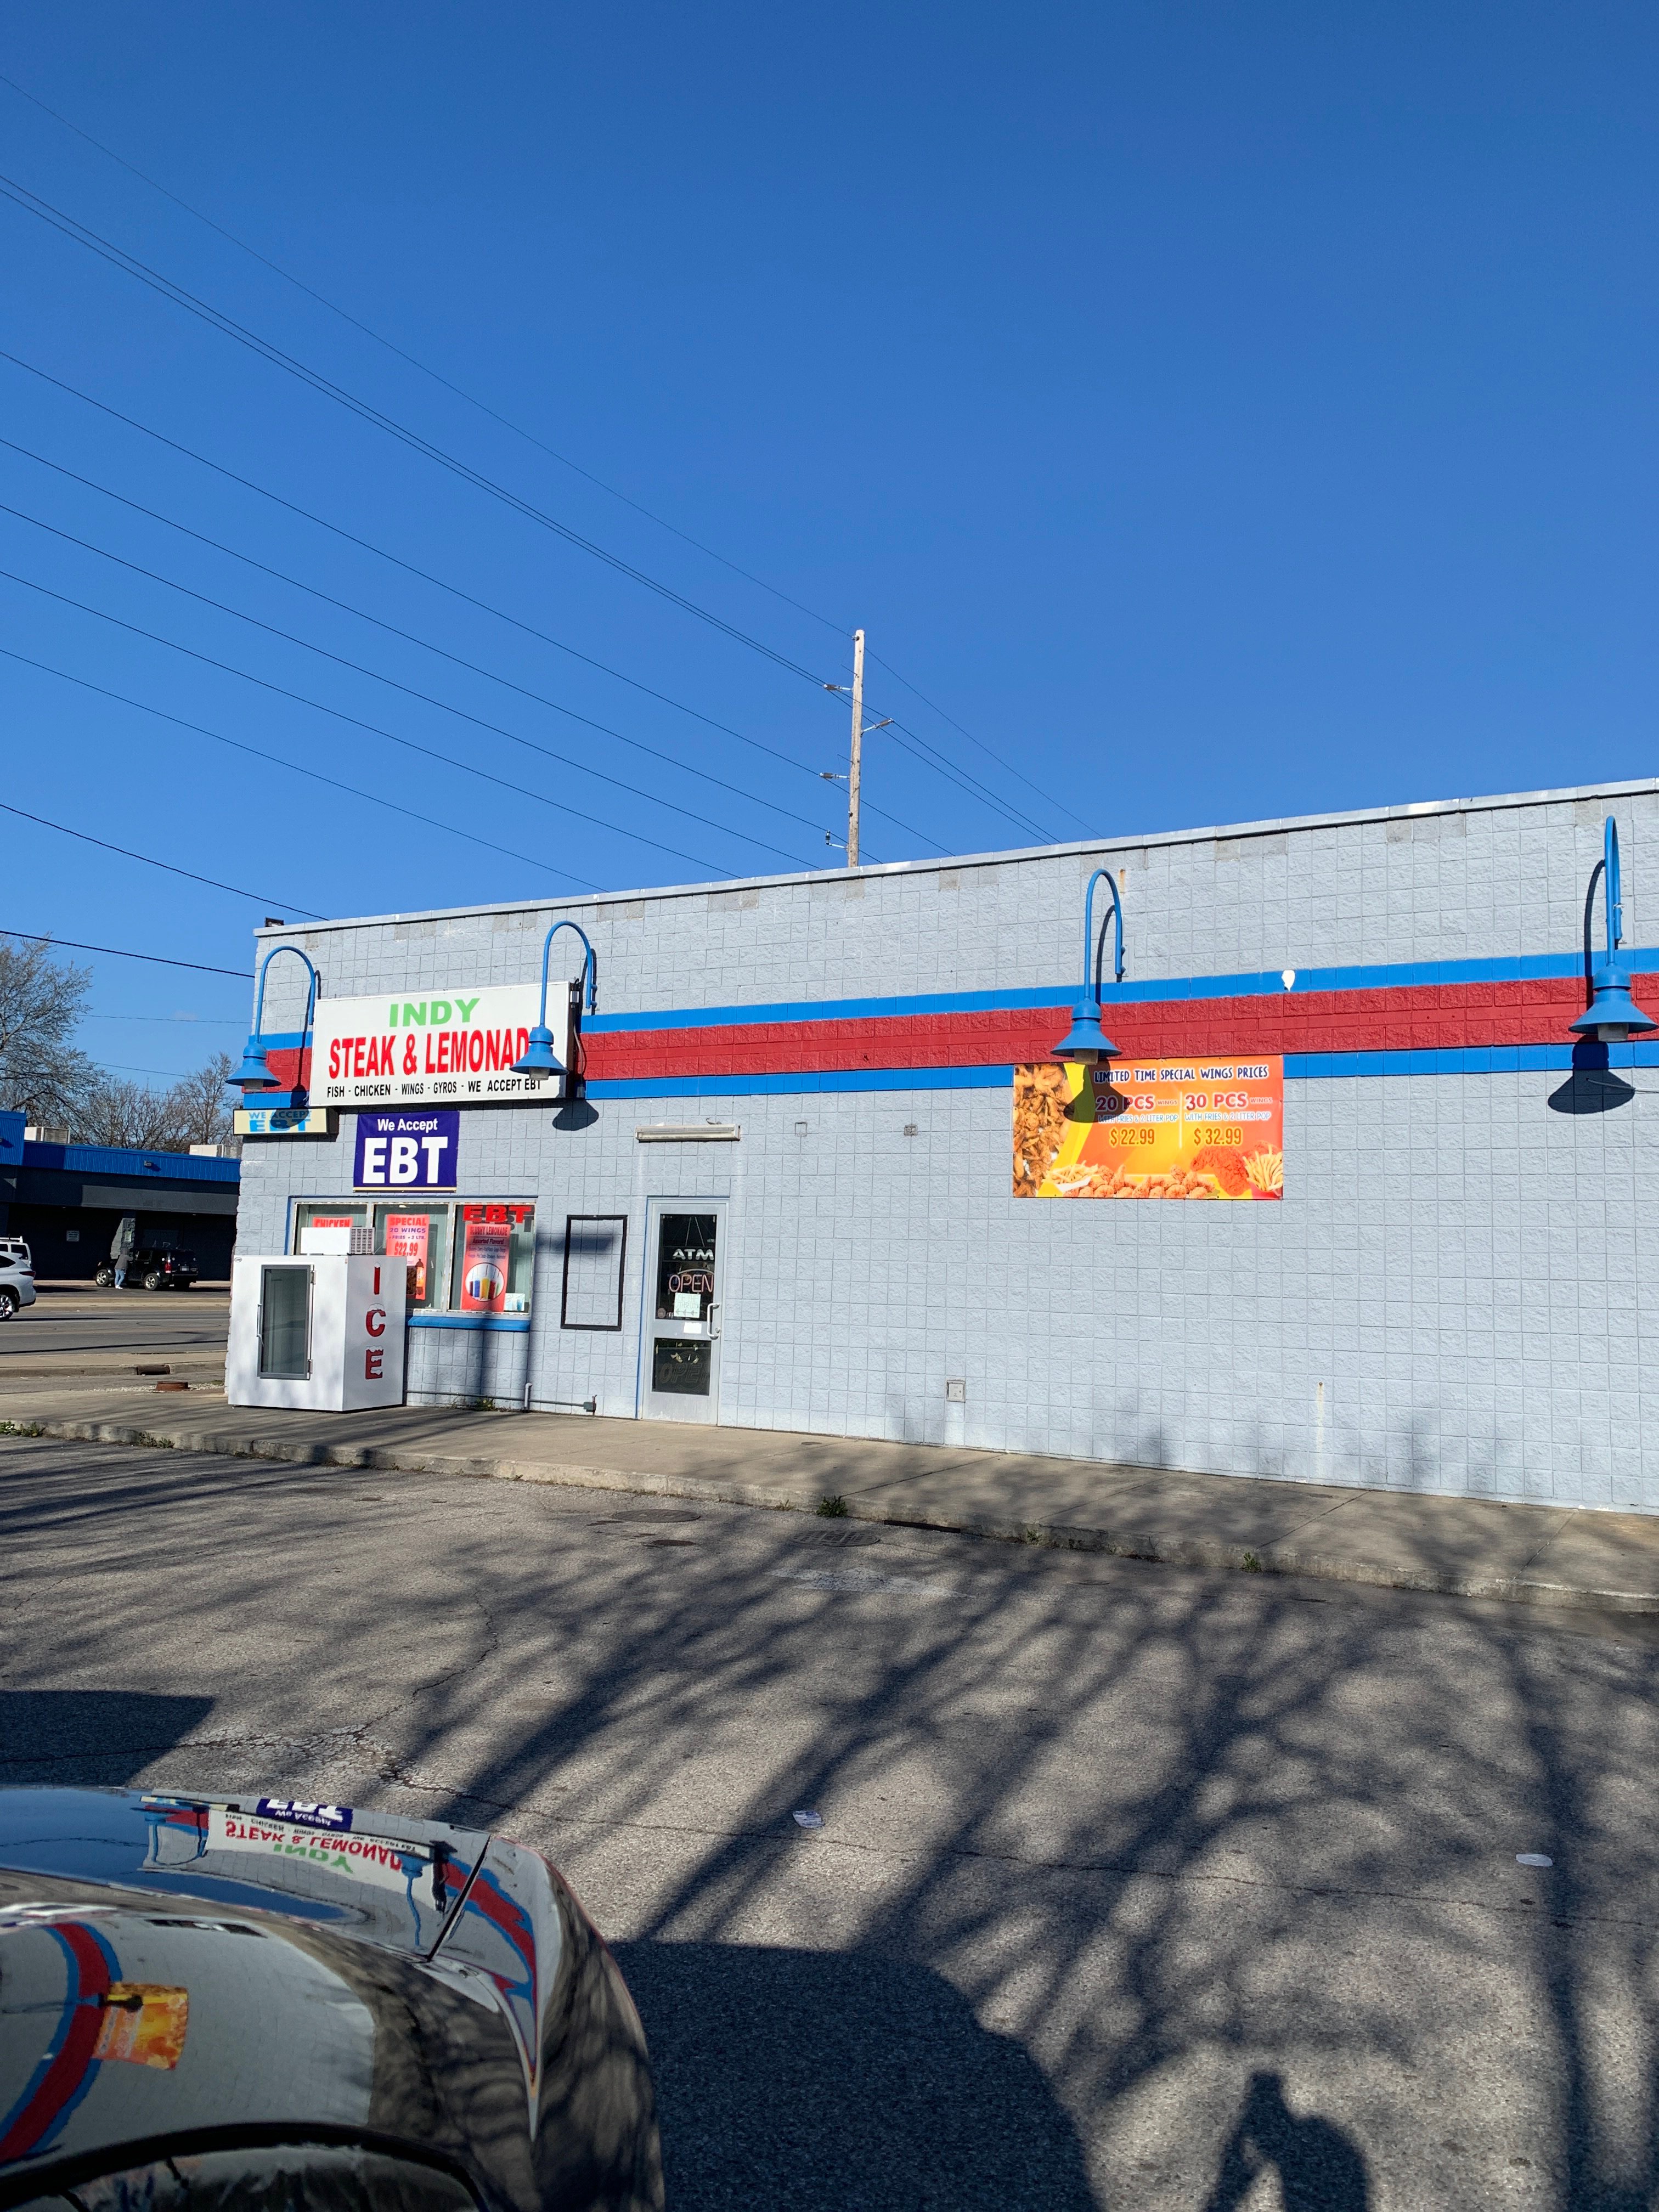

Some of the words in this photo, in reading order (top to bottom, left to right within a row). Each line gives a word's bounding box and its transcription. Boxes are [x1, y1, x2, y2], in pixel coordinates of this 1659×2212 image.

[390, 998, 480, 1027] INDY
[329, 1035, 396, 1079] STEAK
[403, 1034, 417, 1075] &
[425, 1027, 536, 1074] LEMONAD
[1094, 1071, 1130, 1082] LIMITED
[1135, 1070, 1155, 1081] TIME
[1161, 1069, 1195, 1080] SPECIAL
[1200, 1068, 1233, 1079] WINGS
[1238, 1066, 1268, 1078] PRICES
[327, 1086, 345, 1098] FISH
[354, 1084, 391, 1097] CHICKEN
[402, 1083, 424, 1095] WINGS
[433, 1081, 457, 1094] GYROS
[468, 1080, 481, 1092] WE
[487, 1079, 522, 1091] ACCEPT
[524, 1079, 540, 1090] EBT
[1097, 1096, 1117, 1110] 20
[1124, 1096, 1154, 1110] PCS
[1186, 1094, 1206, 1111] 30
[1214, 1093, 1247, 1108] PCS
[250, 1119, 311, 1132] EBT
[377, 1119, 395, 1131] We
[397, 1118, 438, 1133] Accept
[363, 1136, 448, 1183] EBT
[315, 1219, 350, 1227] CHICKEN
[390, 1217, 426, 1226] SPECIAL
[463, 1205, 531, 1223] EBT
[673, 1248, 714, 1260] ATM
[669, 1274, 713, 1293] OPEN
[365, 1262, 386, 1379] ICE
